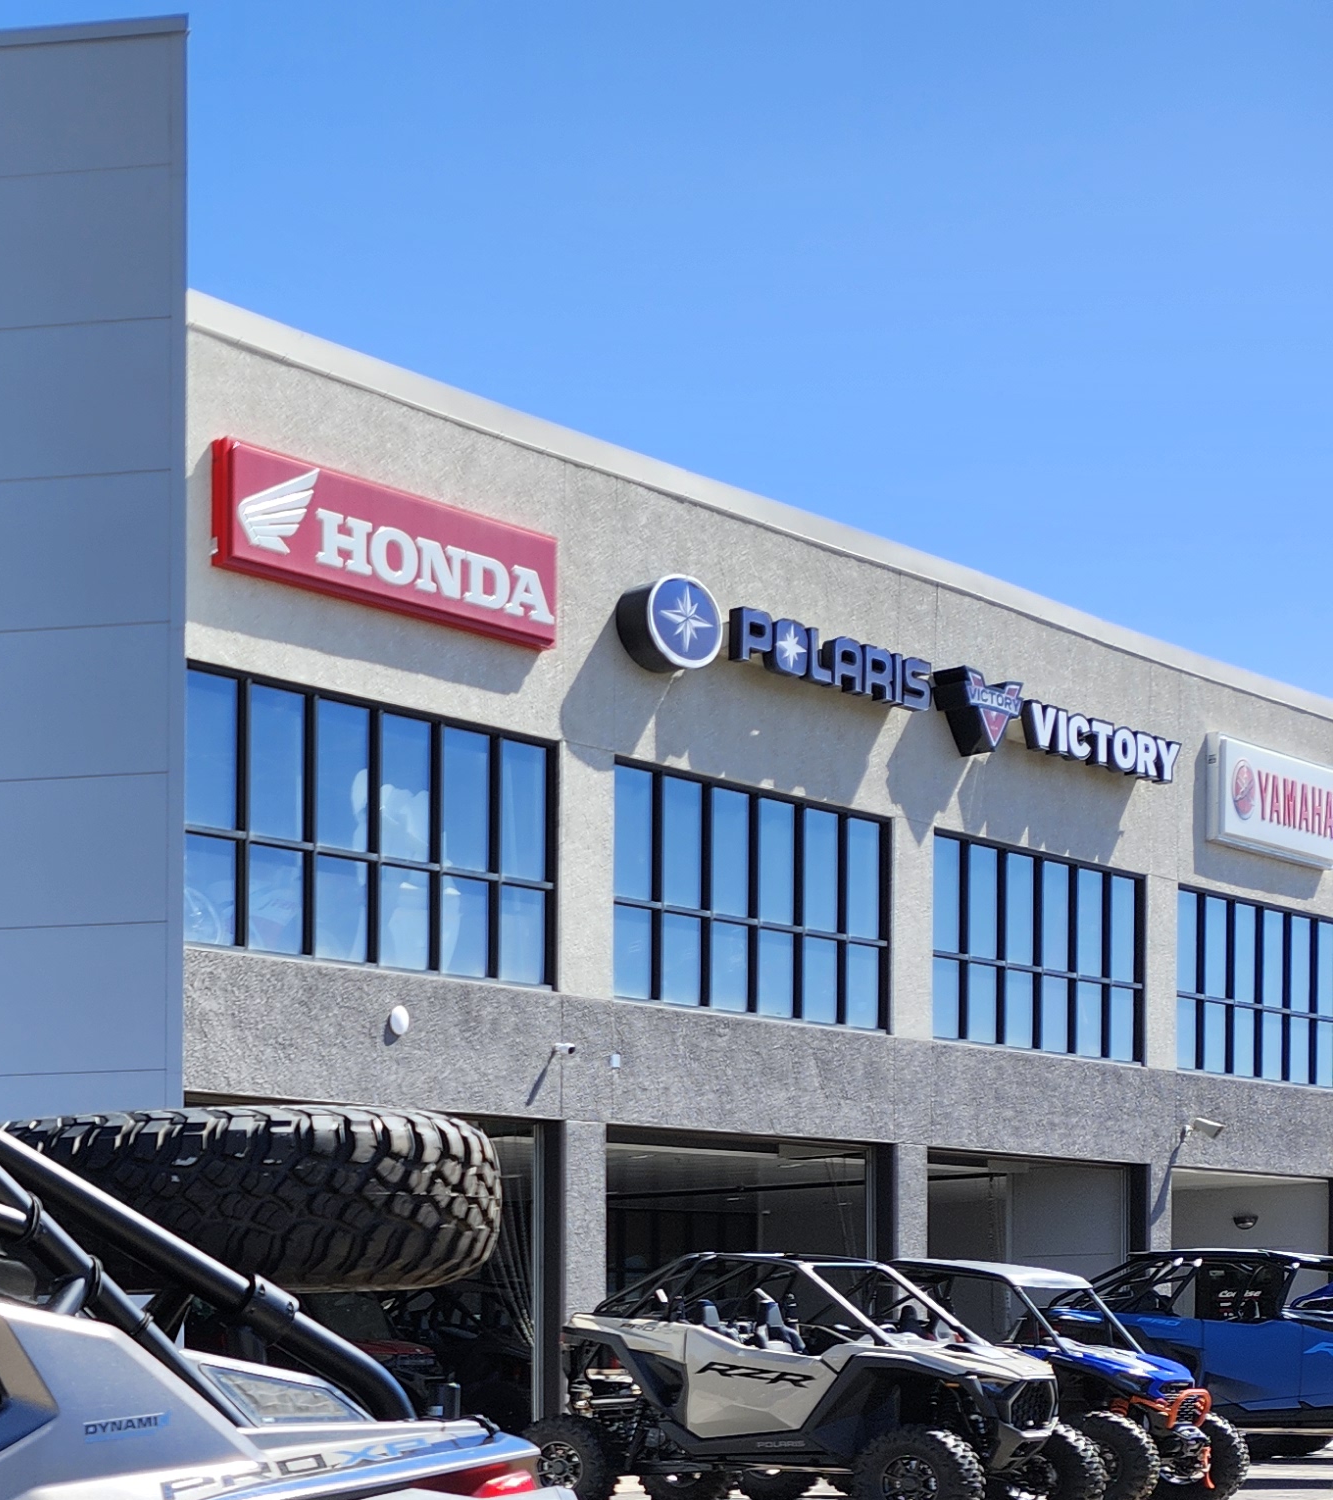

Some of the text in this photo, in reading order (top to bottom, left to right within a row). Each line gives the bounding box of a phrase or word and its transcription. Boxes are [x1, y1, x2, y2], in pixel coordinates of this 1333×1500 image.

[315, 508, 555, 625] HONDA
[728, 606, 932, 711] POLARIS
[968, 684, 1021, 714] VICTORY
[1029, 701, 1182, 783] VICTORY
[1257, 769, 1333, 840] YAMAHA
[694, 1361, 817, 1389] RZR
[756, 1440, 806, 1448] POLARIS
